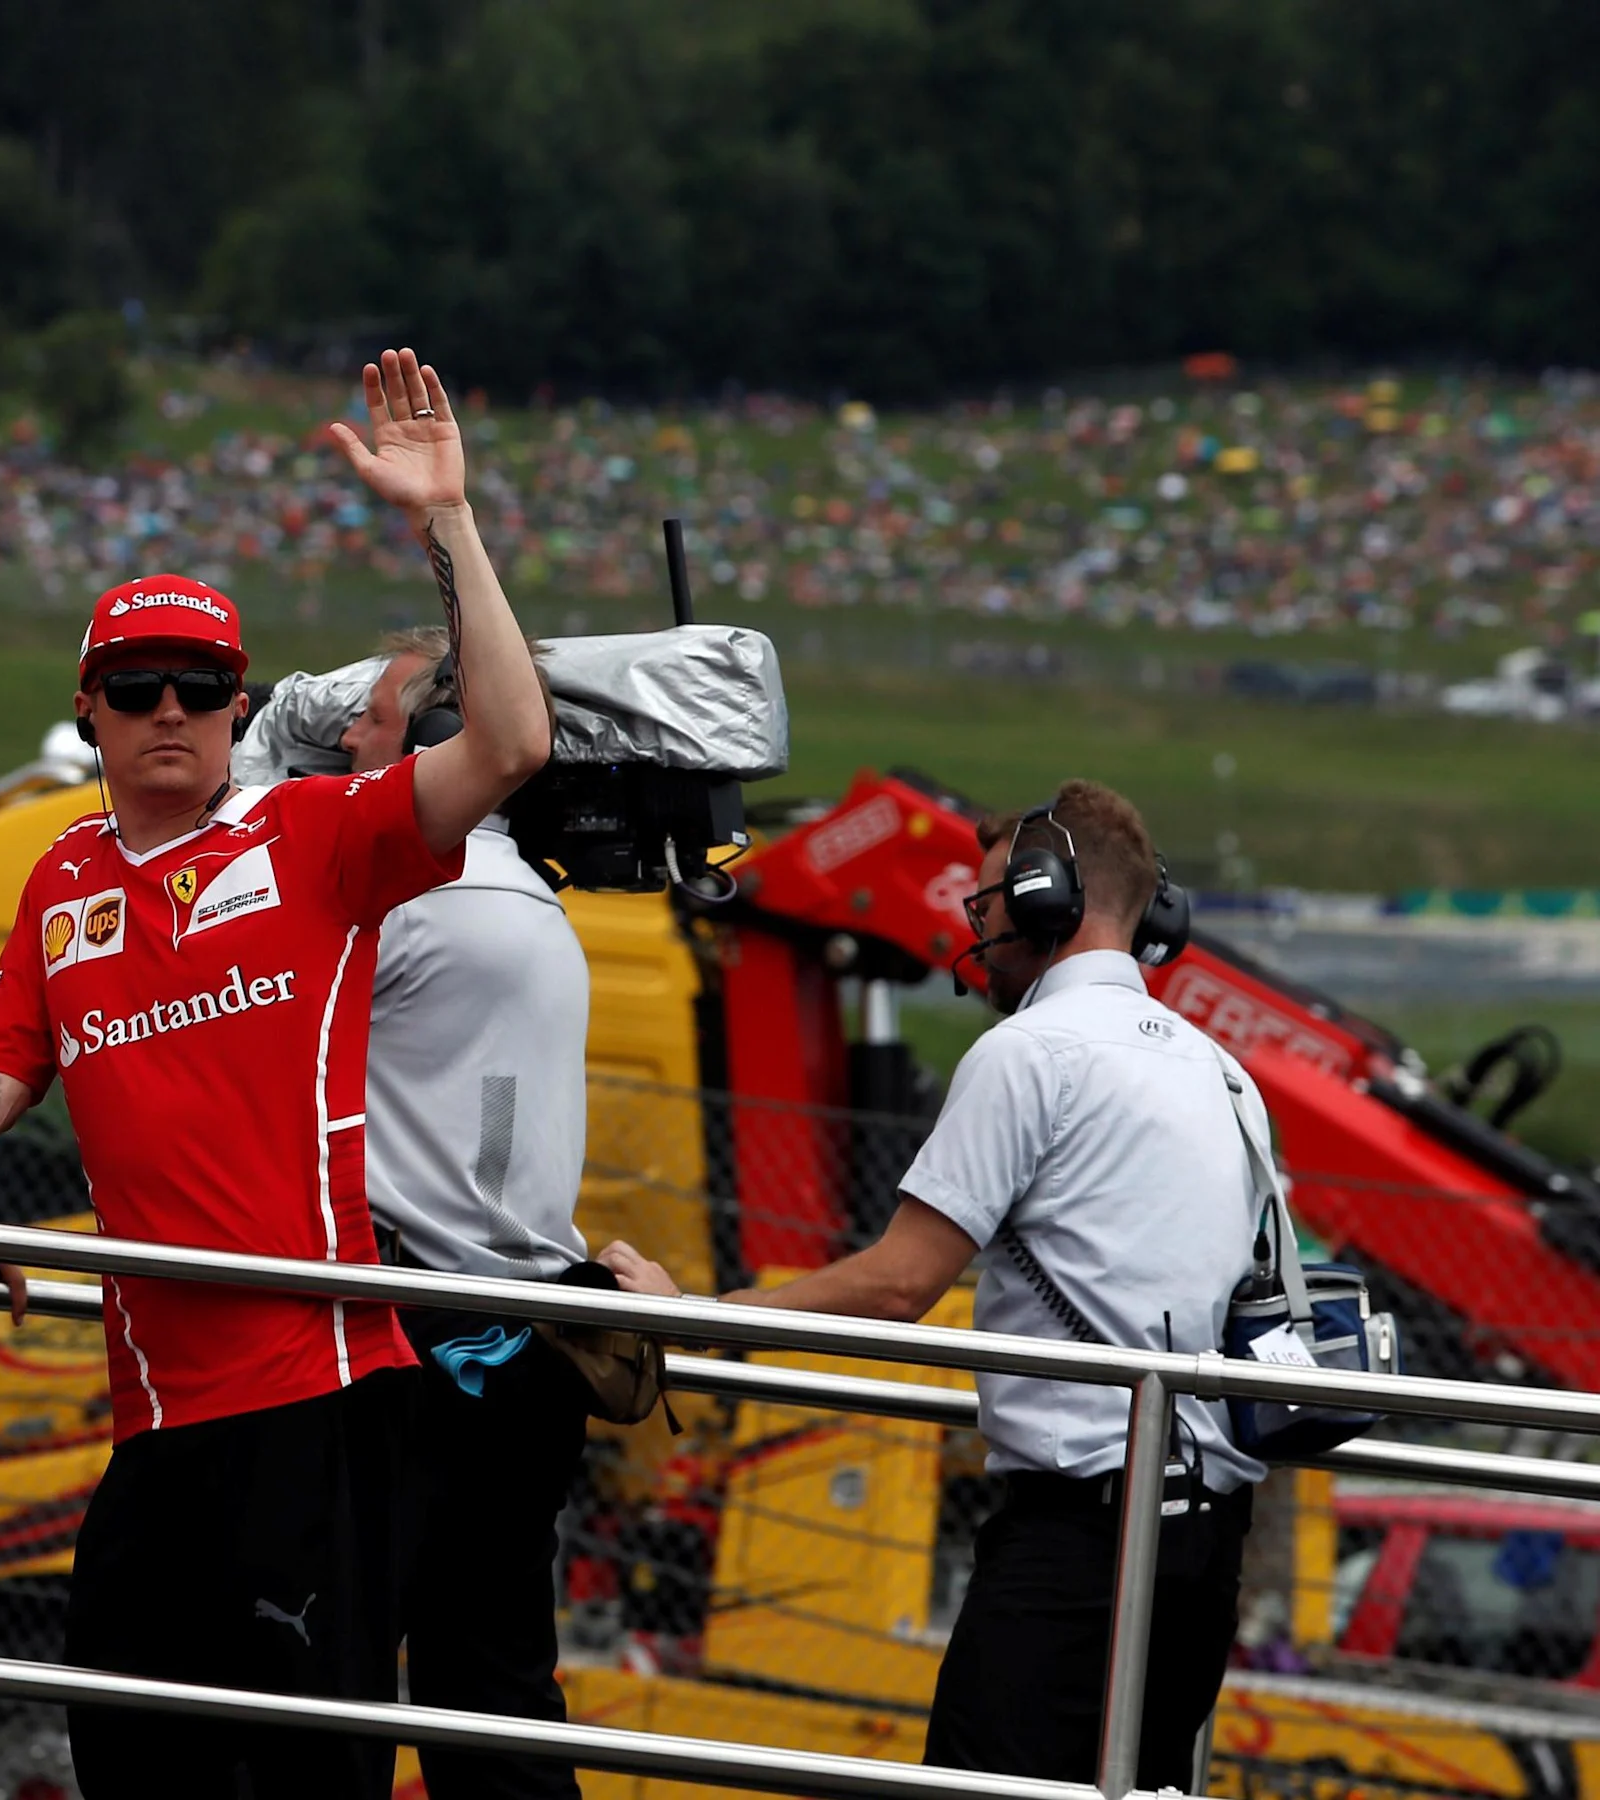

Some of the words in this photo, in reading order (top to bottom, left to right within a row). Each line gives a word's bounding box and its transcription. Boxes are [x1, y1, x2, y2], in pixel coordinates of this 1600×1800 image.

[132, 592, 228, 623] Santander
[198, 891, 253, 916] SCUDERIA
[220, 895, 268, 916] FERRARI
[87, 908, 118, 940] ups
[82, 965, 296, 1055] Santander
